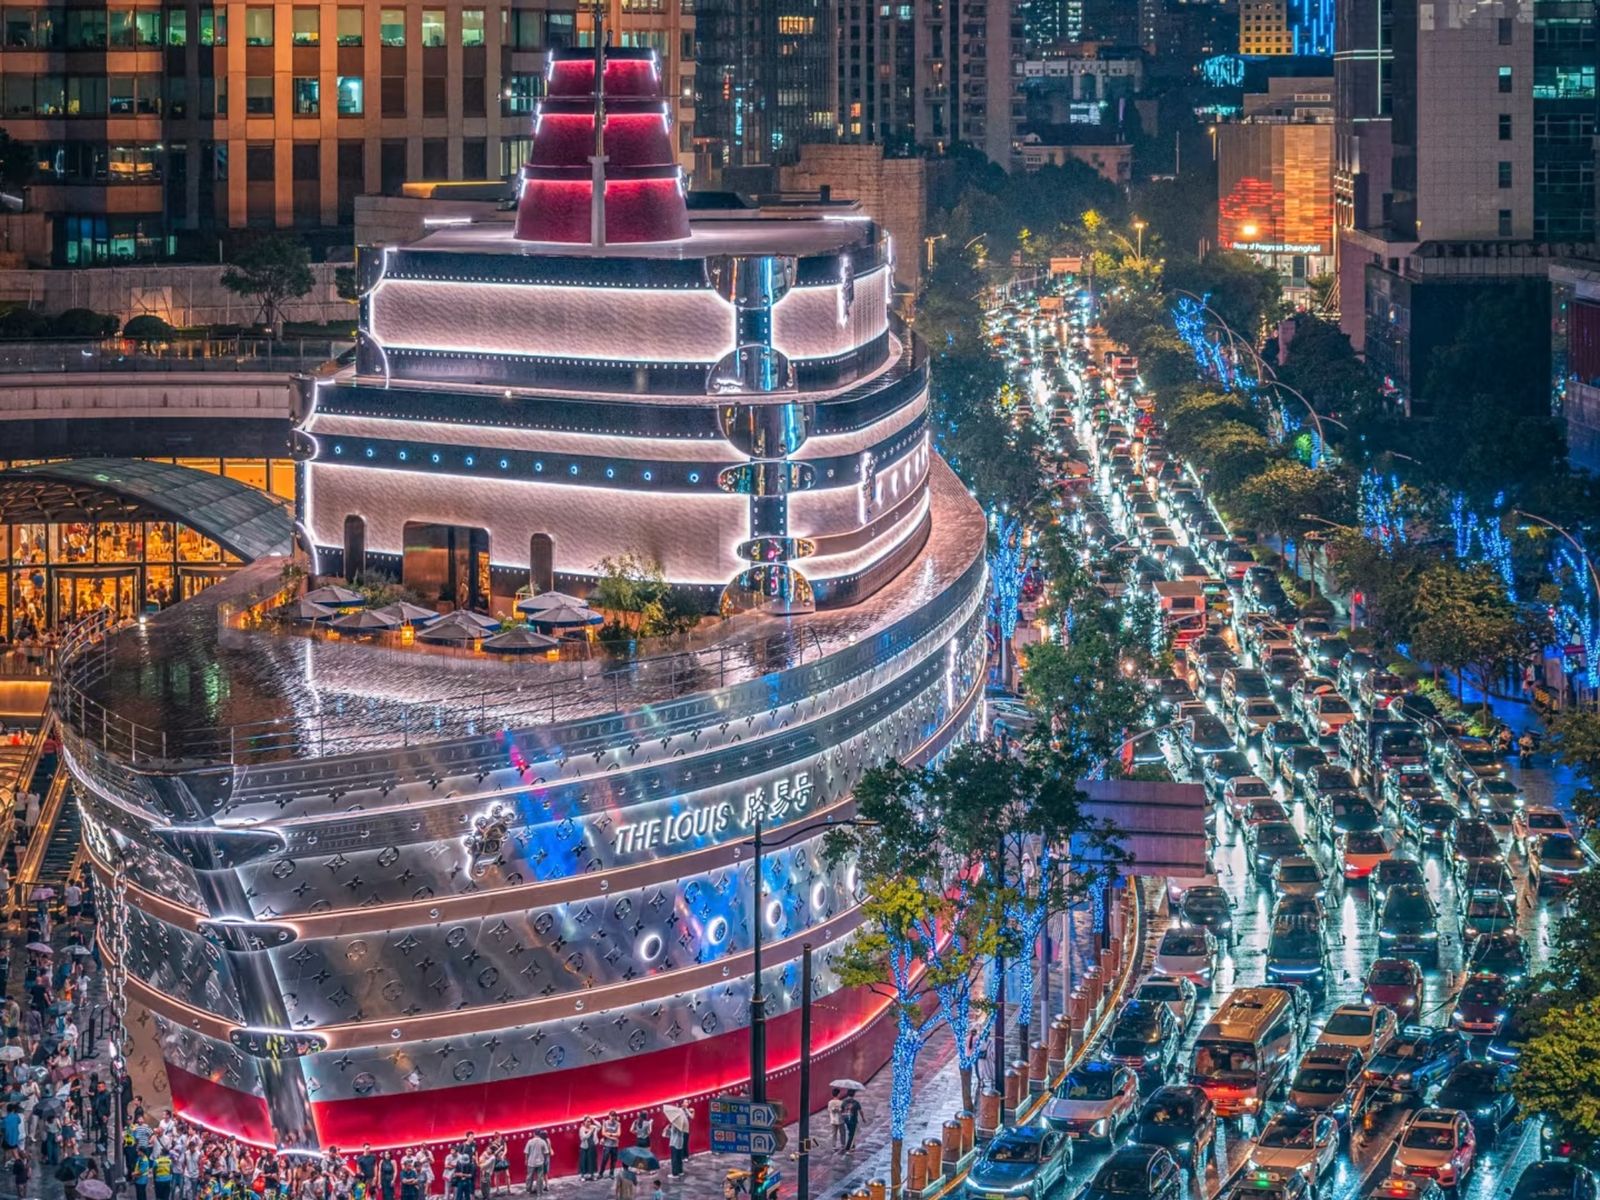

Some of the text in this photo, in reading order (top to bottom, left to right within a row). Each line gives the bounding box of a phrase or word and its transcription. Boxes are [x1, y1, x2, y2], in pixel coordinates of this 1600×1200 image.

[1284, 244, 1321, 254] Shanghai
[741, 772, 815, 828] 路易号
[615, 802, 731, 854] THE LOUIS
